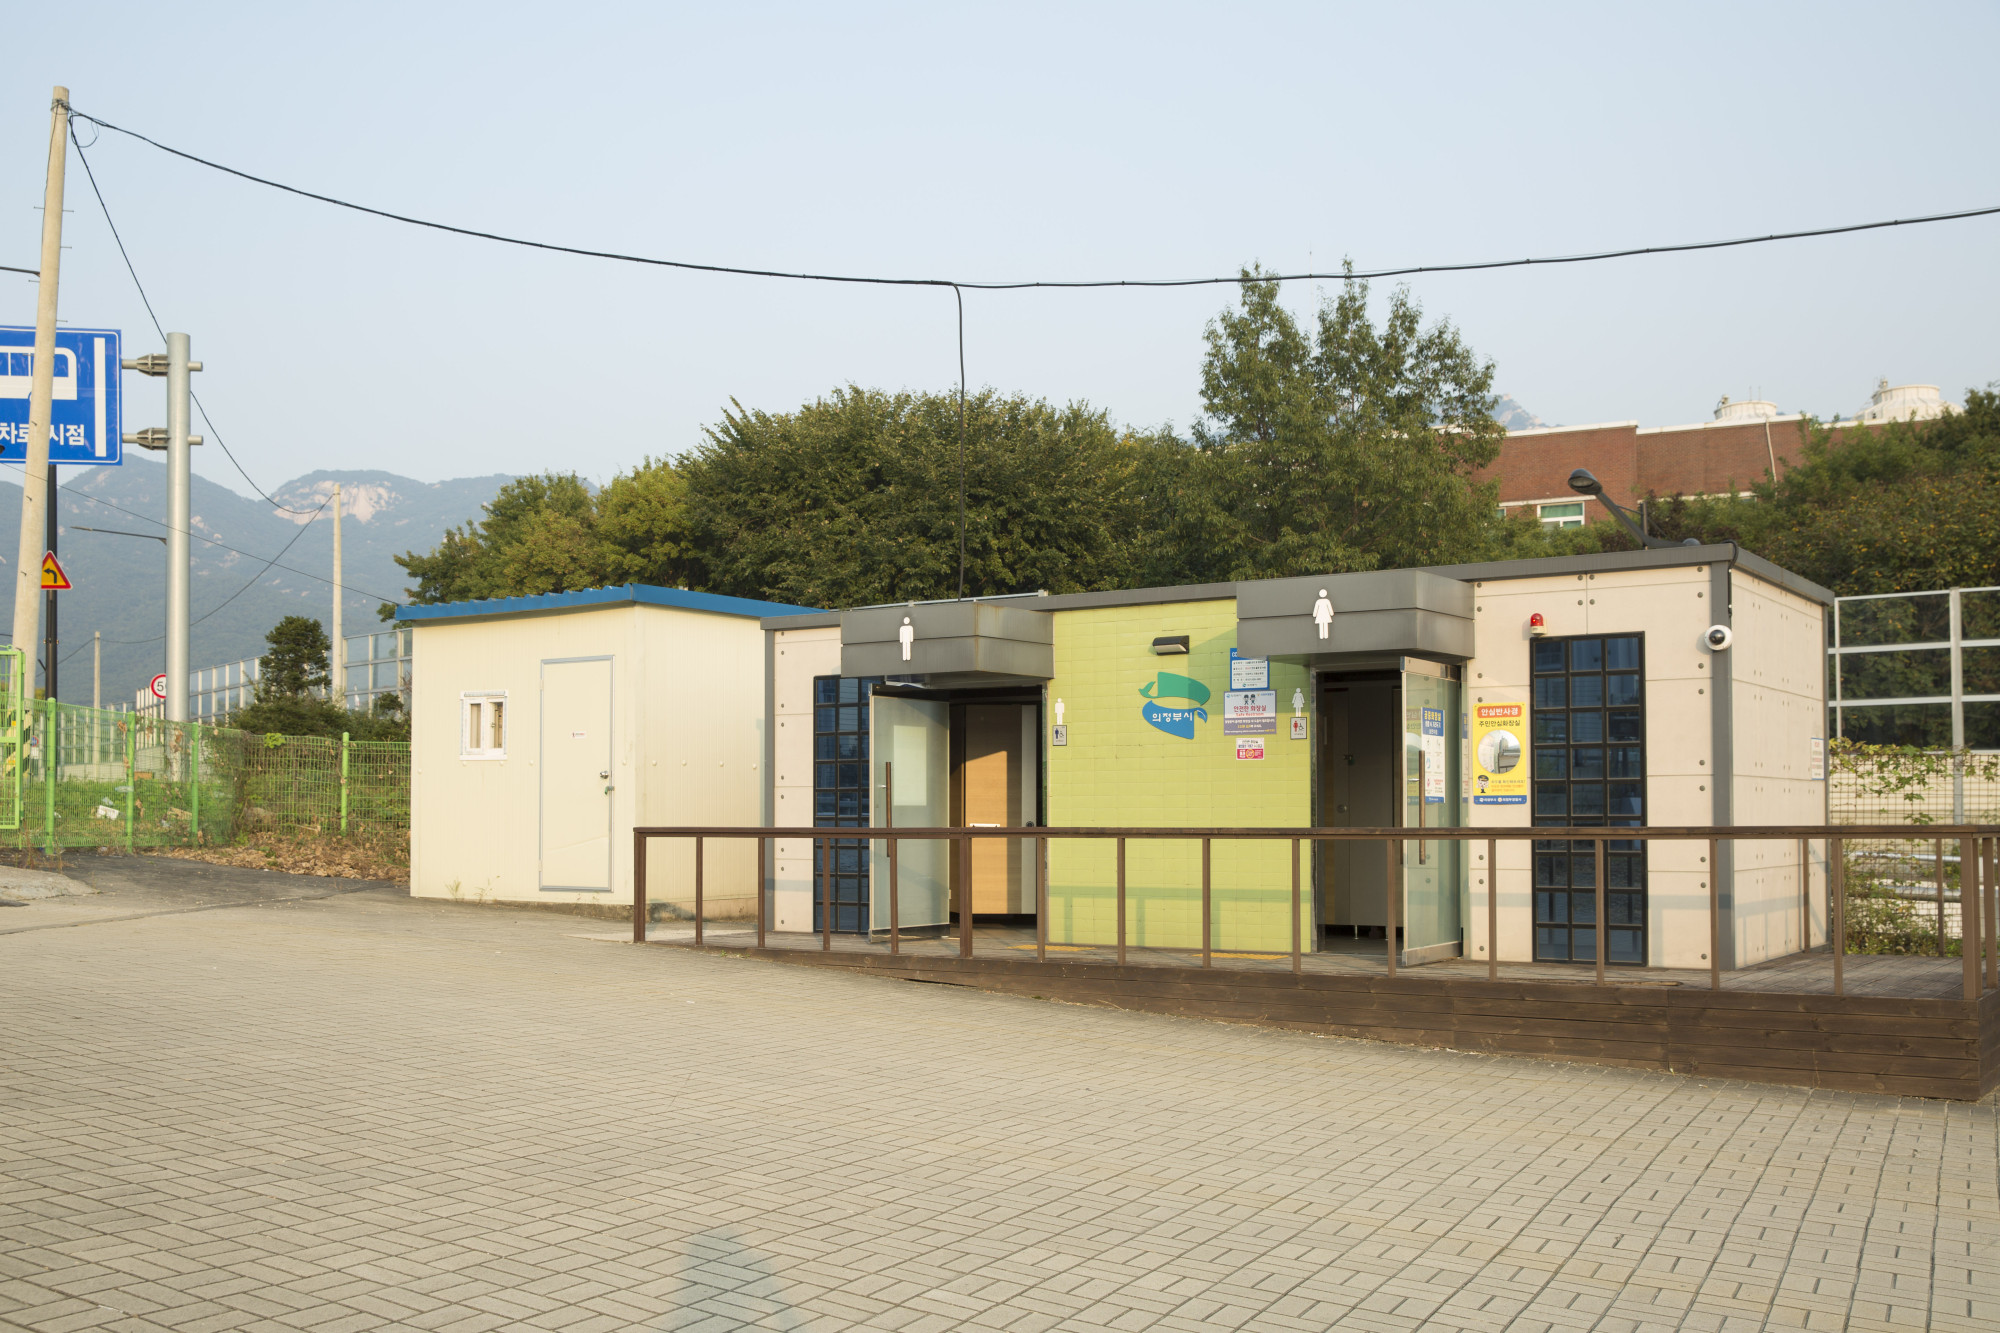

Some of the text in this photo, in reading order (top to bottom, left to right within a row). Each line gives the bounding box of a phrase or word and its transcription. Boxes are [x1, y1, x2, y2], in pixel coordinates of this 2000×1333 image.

[49, 423, 84, 446] 시점
[1233, 704, 1267, 713] 안전한 화장실
[1481, 707, 1519, 717] 안심반사경
[1152, 712, 1193, 723] 의정부시
